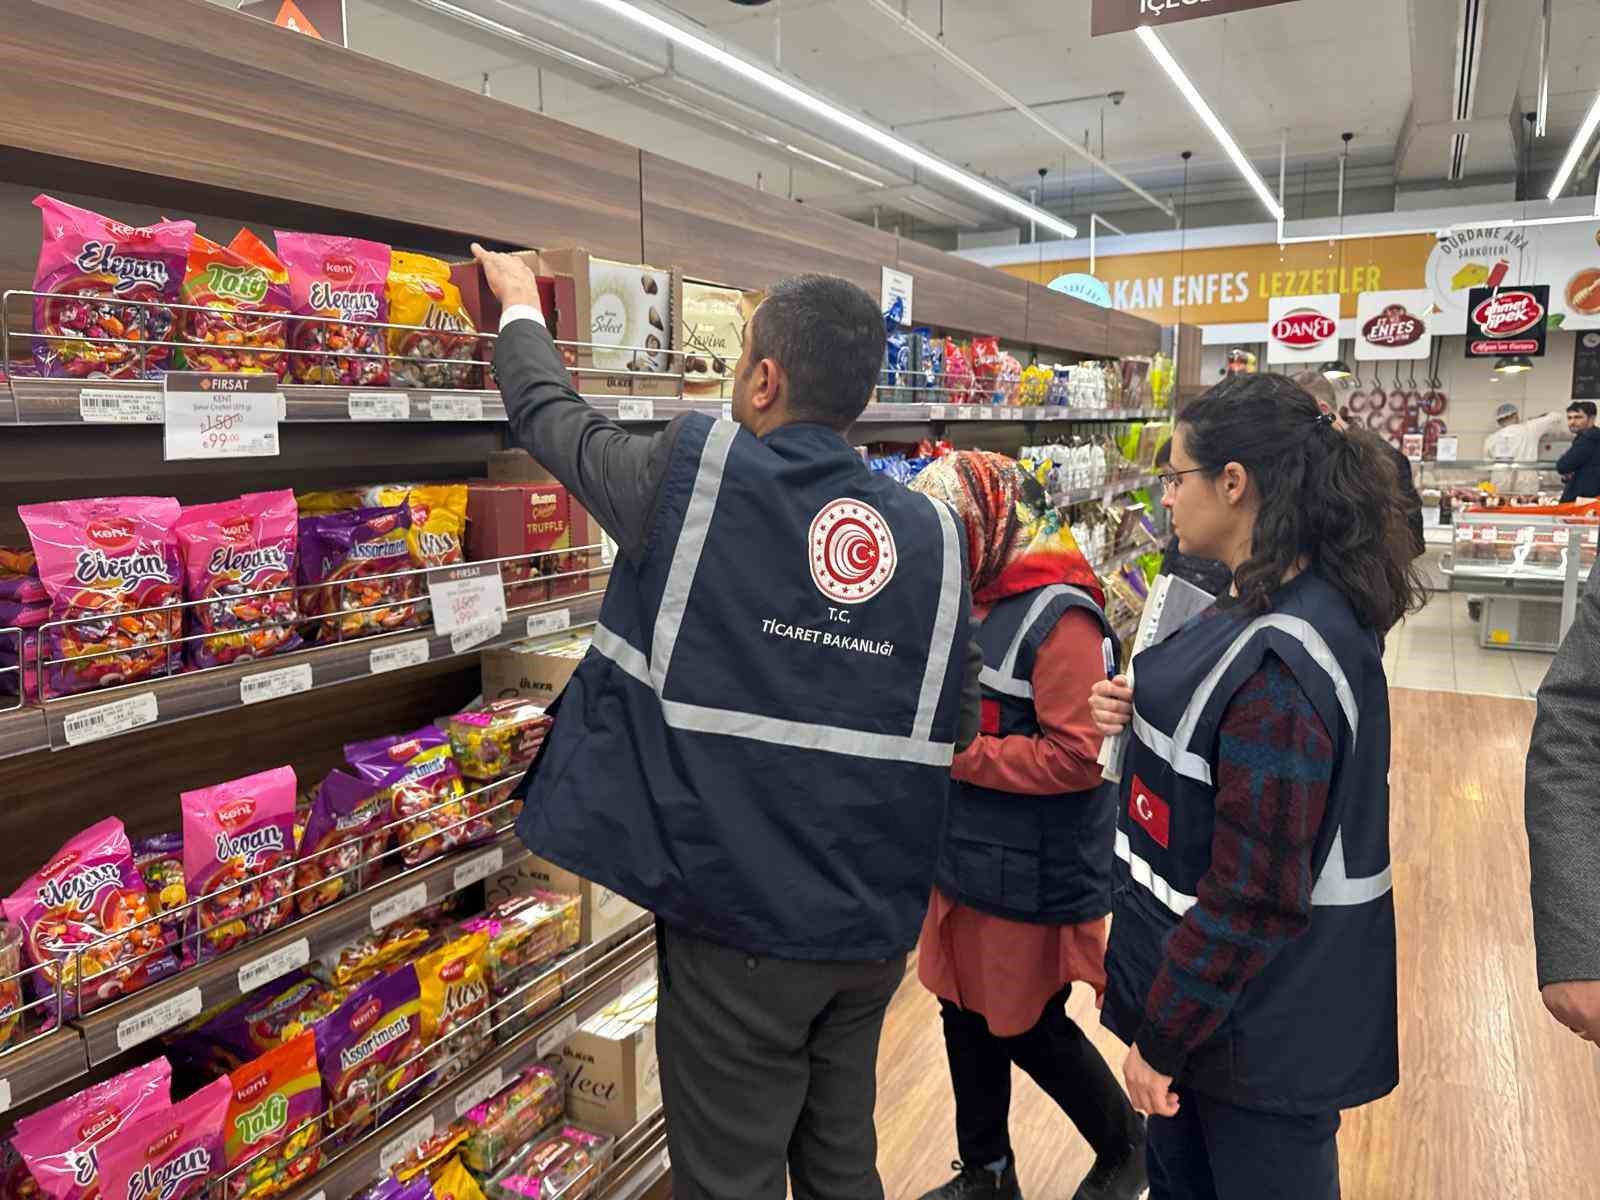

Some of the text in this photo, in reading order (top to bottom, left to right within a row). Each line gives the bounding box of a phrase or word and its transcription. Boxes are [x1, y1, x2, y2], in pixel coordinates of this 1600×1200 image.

[76, 241, 168, 294] Elegan
[325, 262, 354, 275] kent
[1106, 275, 1164, 310] KAN
[1173, 271, 1249, 307] ENFES
[1258, 264, 1382, 298] LEZZETLER
[1276, 317, 1333, 340] DANET
[1370, 320, 1415, 339] ENFES
[211, 378, 249, 391] FIRSAT
[91, 526, 131, 539] kent
[527, 520, 565, 534] TRUFFLE
[208, 545, 289, 584] Elegan
[828, 606, 851, 624] T.C.
[761, 618, 894, 657] TİCARET BAKANLIĞI
[218, 803, 254, 822] kent
[352, 1004, 378, 1028] kent
[339, 1015, 411, 1071] Assortment
[237, 1075, 268, 1101] kent
[81, 1112, 119, 1138] kent
[127, 1146, 211, 1200] Elegan
